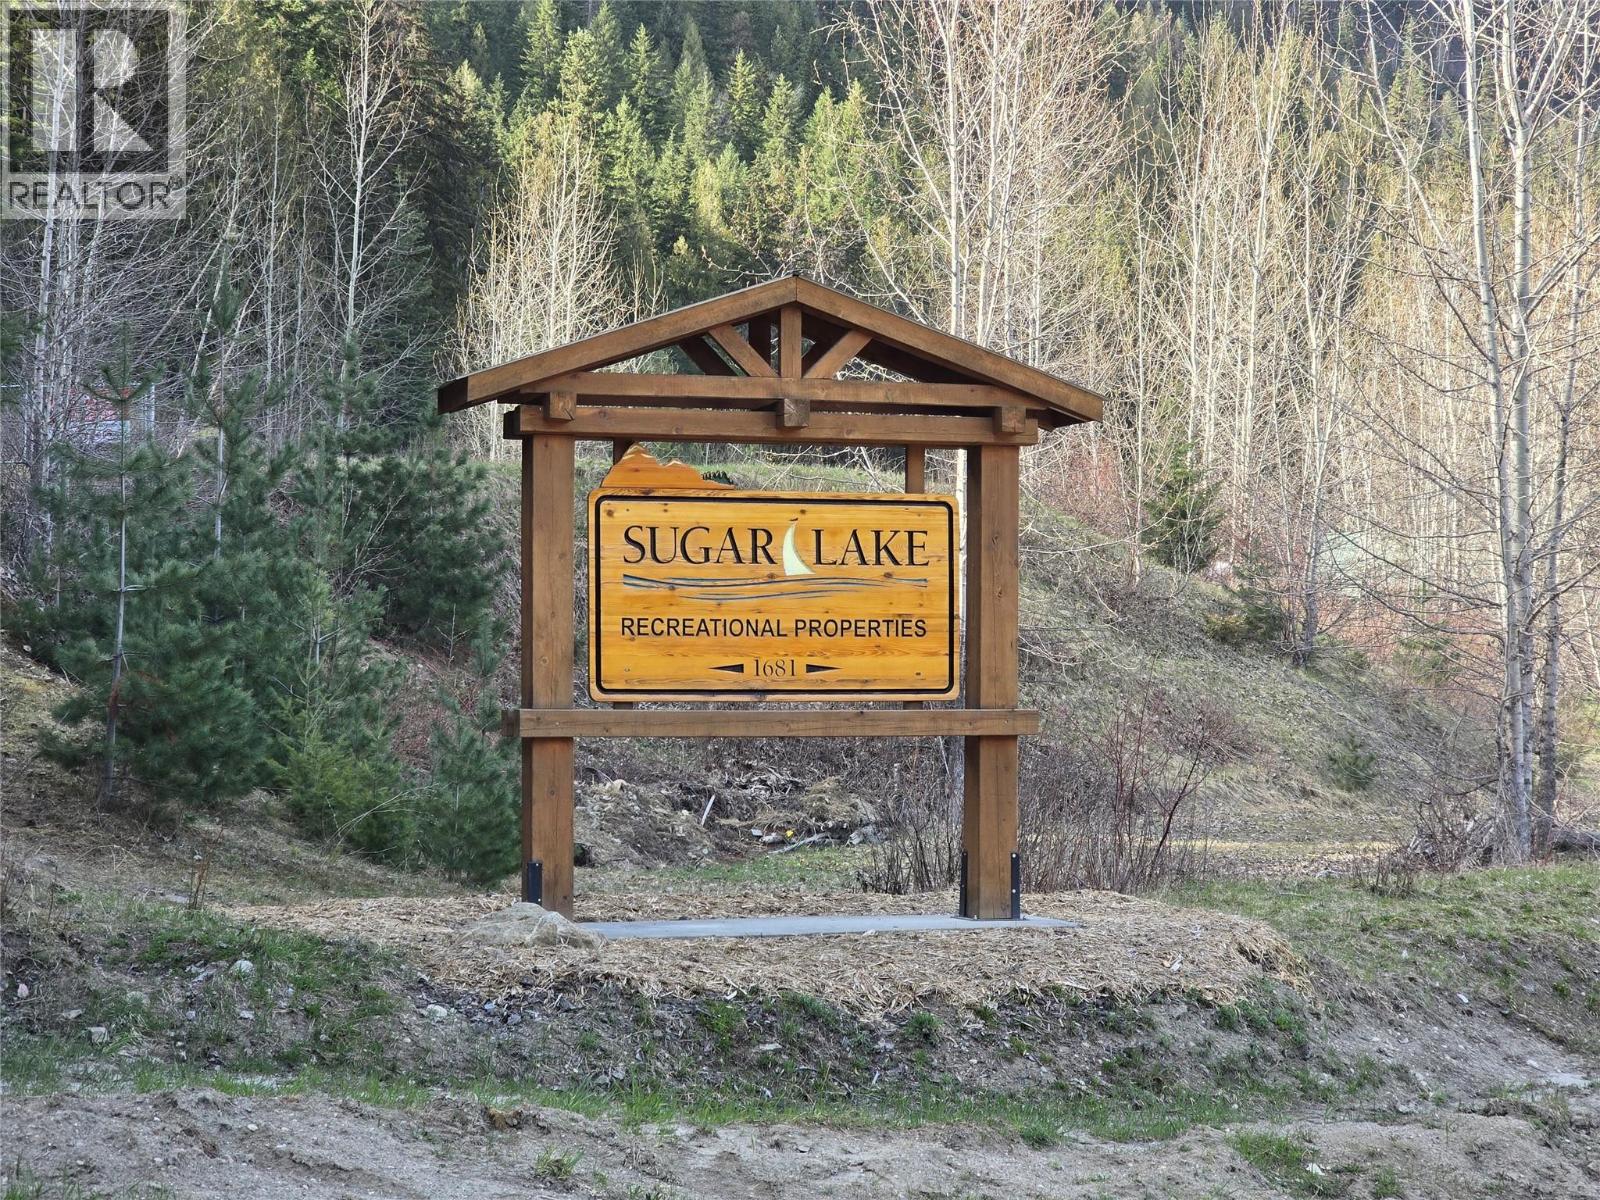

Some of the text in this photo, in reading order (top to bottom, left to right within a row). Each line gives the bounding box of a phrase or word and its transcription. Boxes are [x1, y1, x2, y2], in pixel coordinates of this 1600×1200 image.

[623, 525, 930, 567] SUGAR LAKE
[620, 617, 927, 638] RECREATIONAL PROPERTIES
[753, 658, 797, 678] 1681
